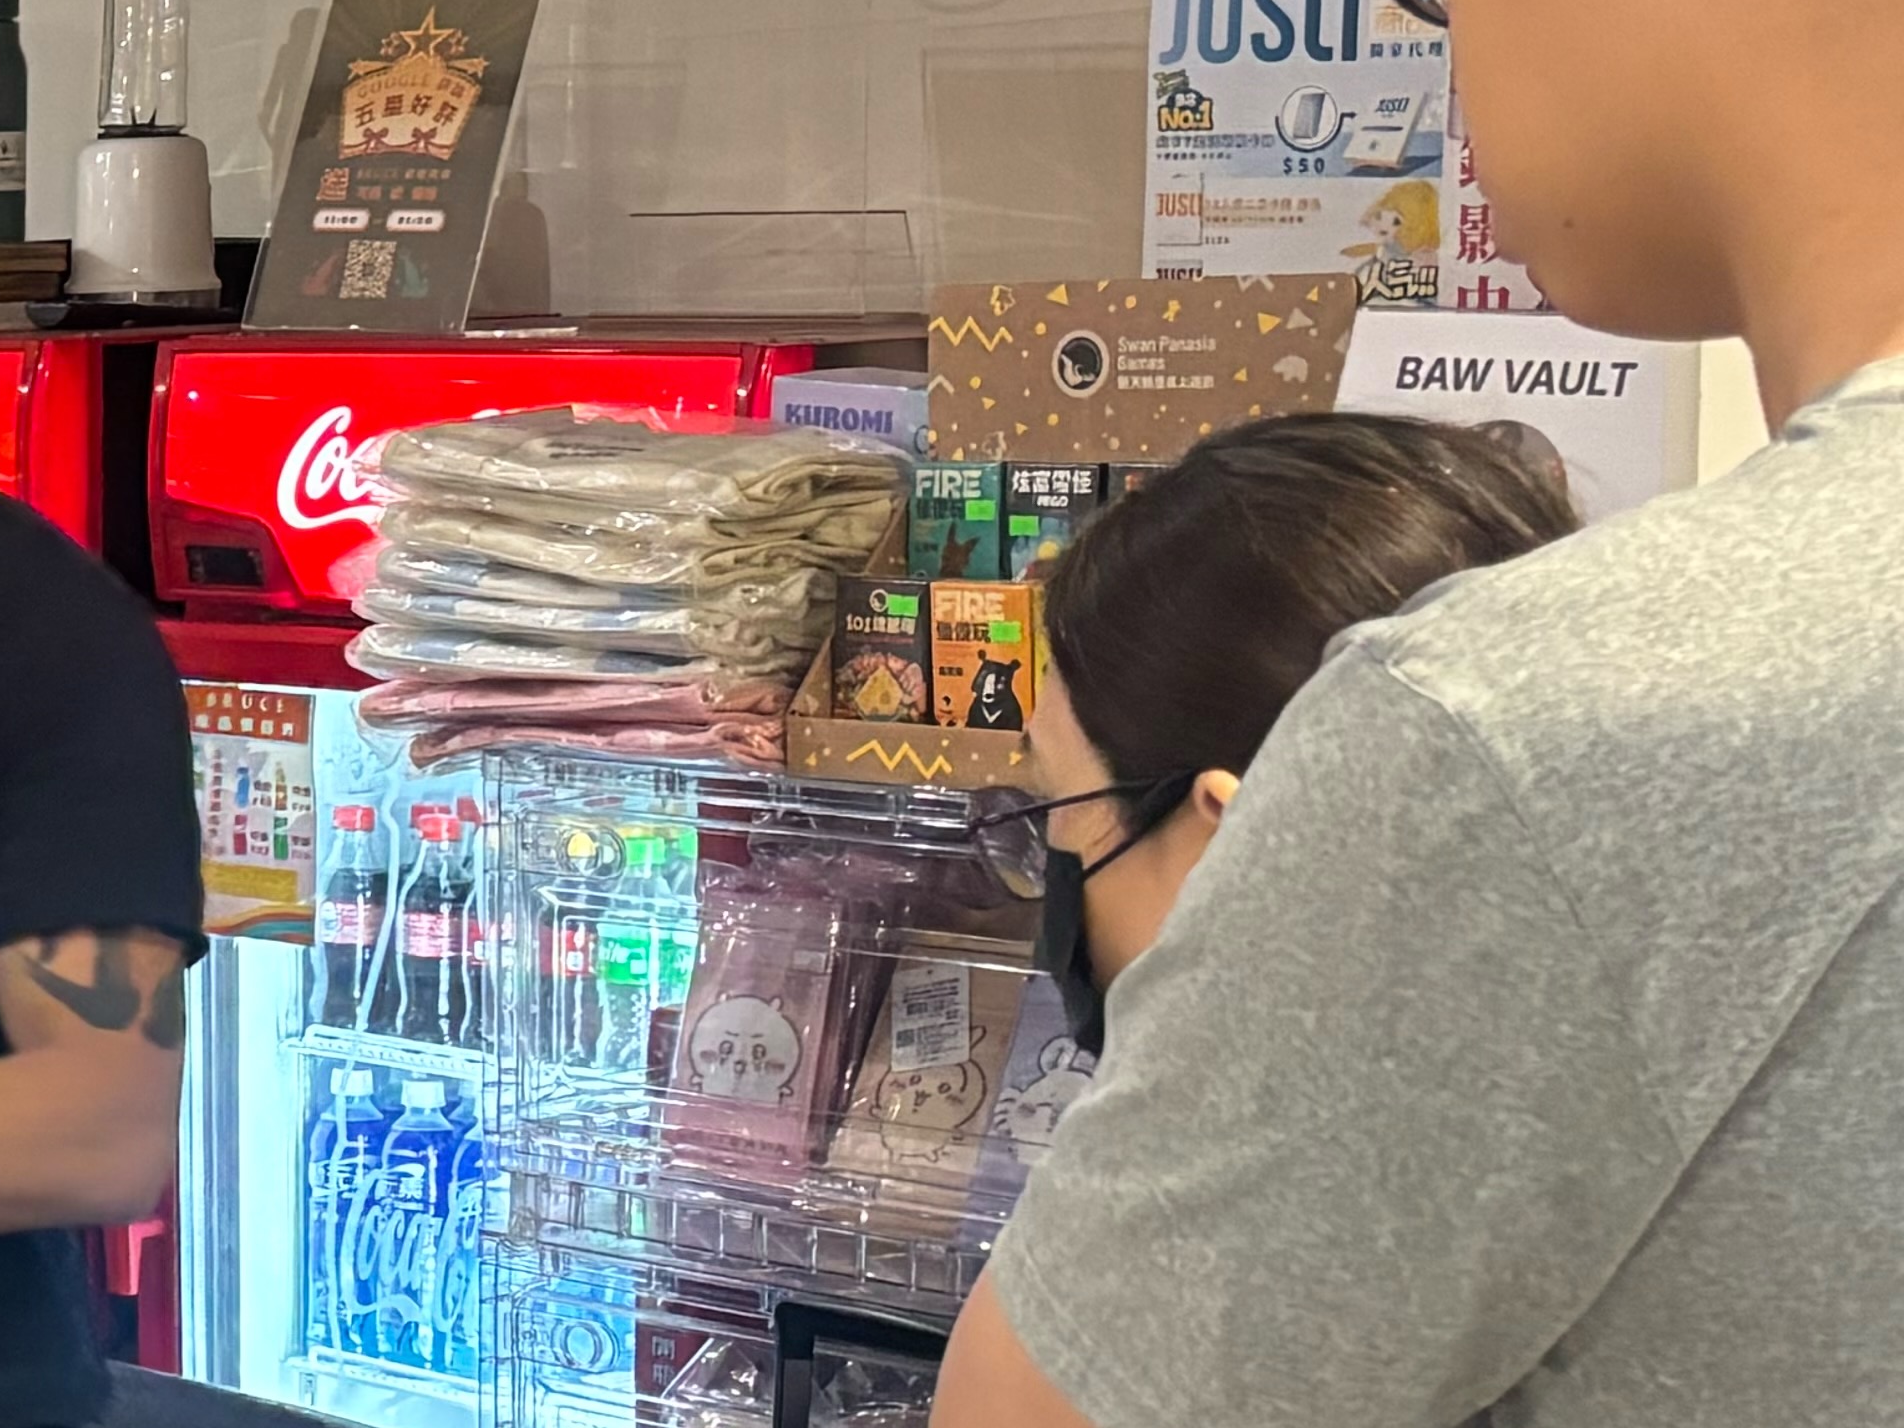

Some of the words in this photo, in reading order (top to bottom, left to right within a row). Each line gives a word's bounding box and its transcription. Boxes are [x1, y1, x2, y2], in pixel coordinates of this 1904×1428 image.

[354, 93, 459, 128] 五星好評
[1118, 334, 1158, 354] Swan
[1159, 334, 1217, 354] Panasia
[1118, 355, 1166, 372] Games
[1396, 355, 1494, 392] BAW
[1503, 359, 1639, 399] VAULT
[785, 403, 894, 434] KUROMI
[915, 468, 983, 499] FIRE
[934, 589, 1006, 622] FIRE
